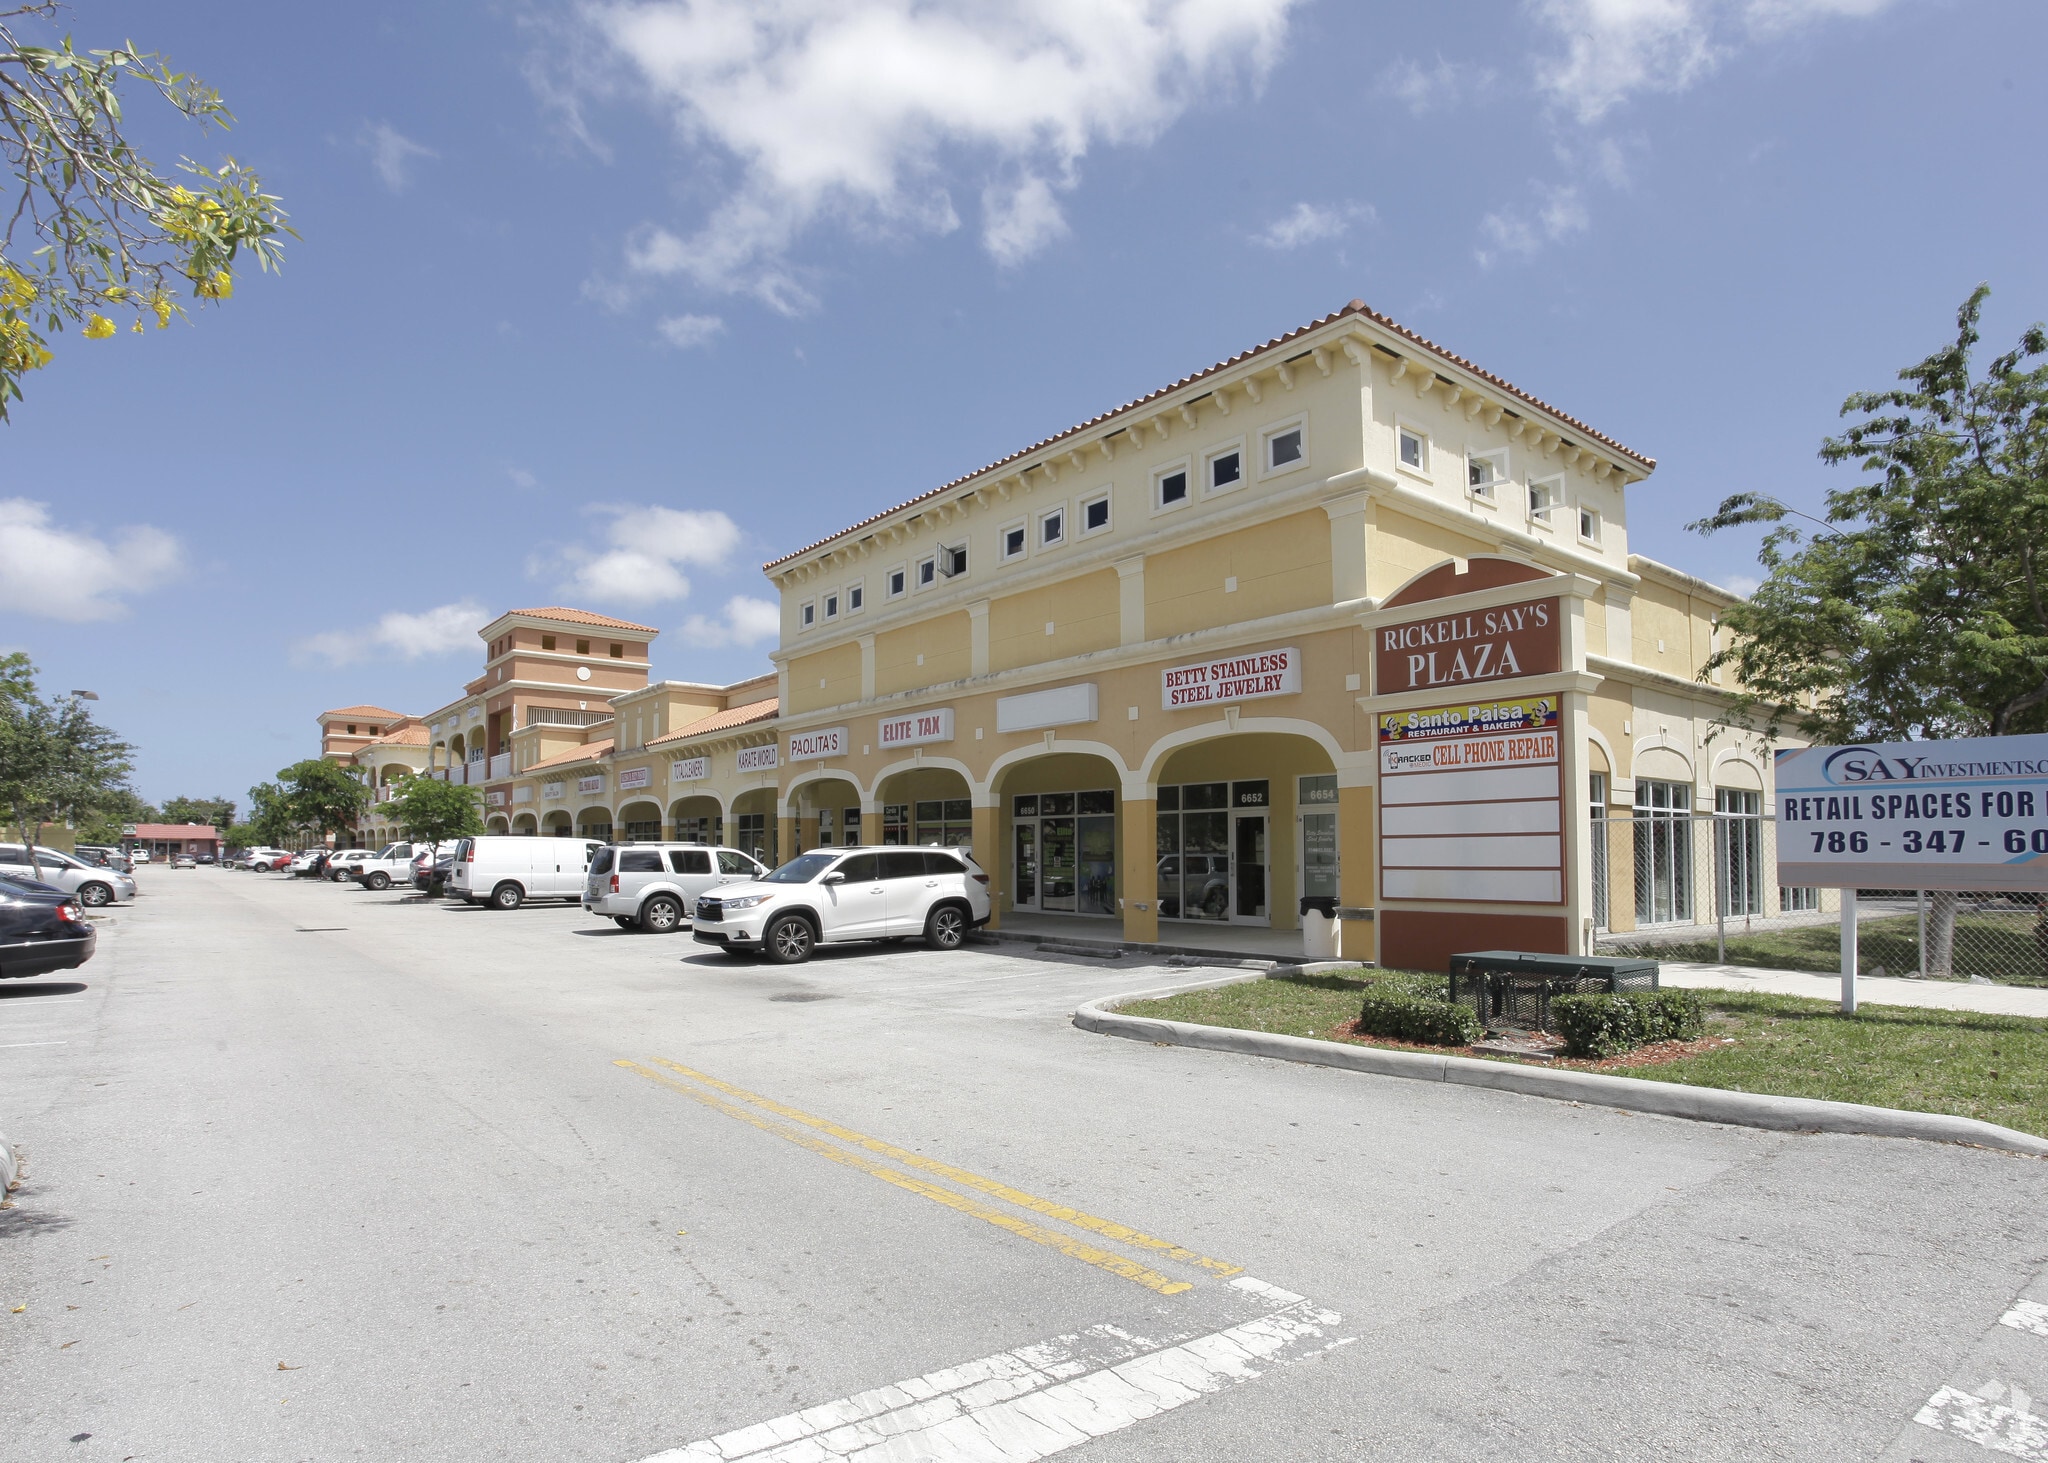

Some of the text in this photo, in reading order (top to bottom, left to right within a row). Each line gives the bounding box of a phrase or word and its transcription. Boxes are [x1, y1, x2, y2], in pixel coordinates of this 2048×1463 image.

[1384, 604, 1548, 651] RICKELL SAY'S
[1166, 653, 1288, 688] BETTY STAINLESS
[1407, 641, 1522, 688] PLAZA
[1171, 674, 1282, 705] STEEL JEWELRY
[883, 716, 940, 742] ELITE TAX
[1407, 704, 1523, 729] Santo Paisa
[1408, 720, 1523, 738] RESTAURANT & BAKERY
[791, 733, 838, 756] PAOLITA'S
[1433, 736, 1555, 766] CELL PHONE REPAIR
[738, 748, 776, 769] KARATE WORLD
[1241, 793, 1263, 804] 6652
[1310, 789, 1334, 800] 6654
[1785, 796, 1863, 821] RETAIL
[1871, 792, 1971, 820] SPACES
[1982, 791, 2034, 818] FOR
[1020, 806, 1035, 815] 6650
[1810, 830, 1868, 854] 786
[1903, 830, 1965, 854] 347
